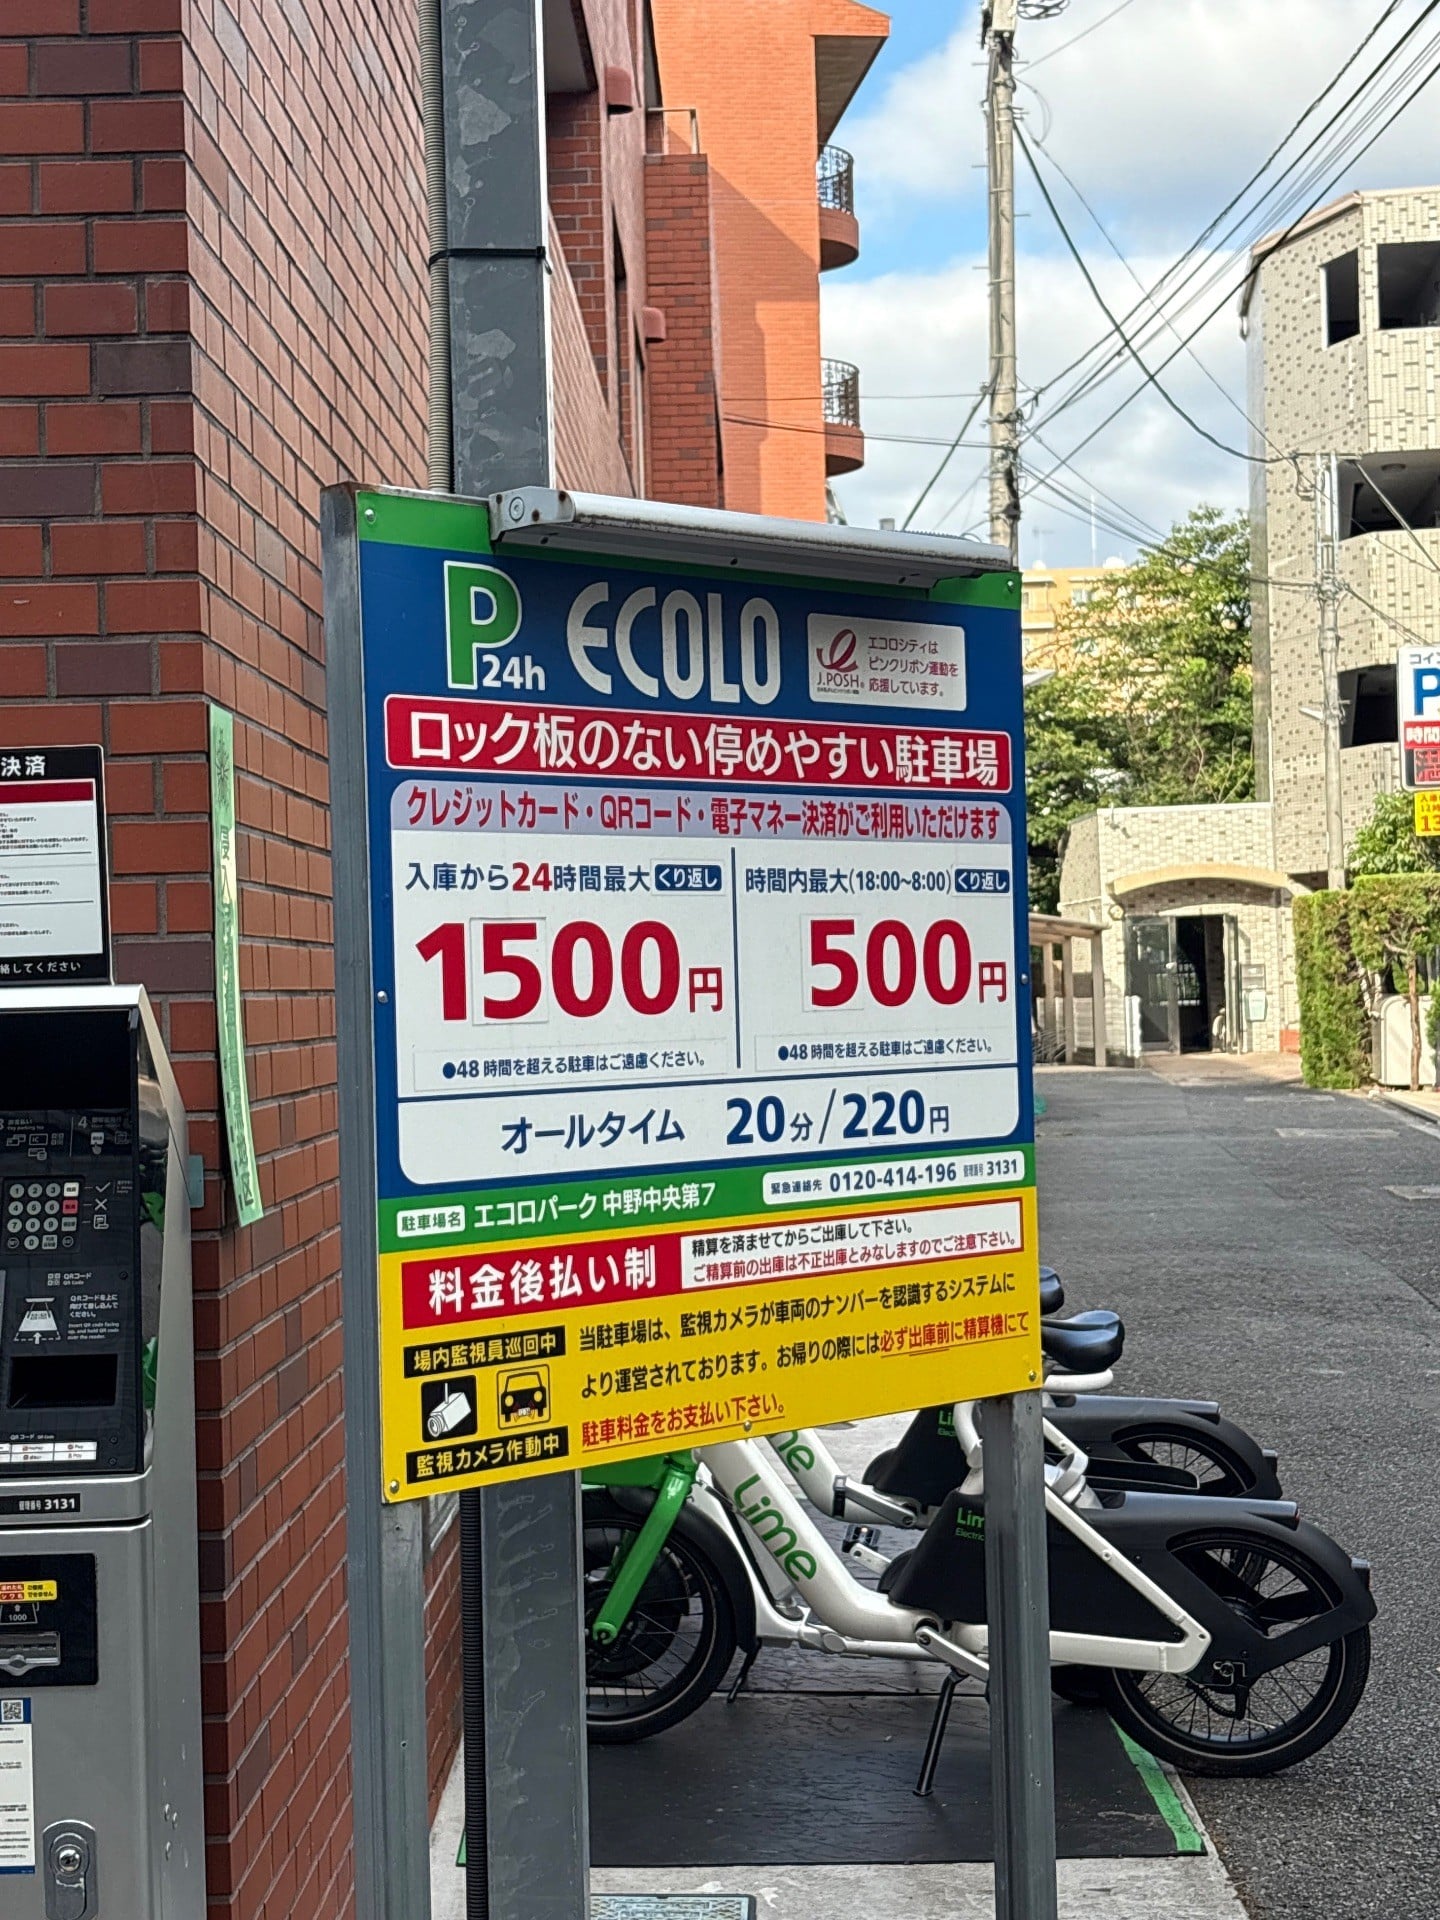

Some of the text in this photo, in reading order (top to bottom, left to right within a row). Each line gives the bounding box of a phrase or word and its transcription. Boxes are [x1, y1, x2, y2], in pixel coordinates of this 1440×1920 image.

[444, 560, 522, 689] P
[567, 582, 781, 705] ECOLO
[868, 636, 938, 655] エコロシティは
[482, 654, 546, 691] 24h
[868, 657, 958, 677] ピンクリボン運動を
[1409, 652, 1440, 664] コイ
[1413, 668, 1440, 715] P
[1, 756, 45, 777] 決済
[411, 712, 998, 787] ロック板のない停めやすい駐車場
[407, 786, 1000, 839] クレジットカード・QRコード・電子マネー決済がご利用いただけます
[405, 862, 718, 892] 入庫から24時間最大 くり返し
[957, 872, 1007, 891] くり返し
[501, 1108, 685, 1154] オールタイム
[771, 1180, 822, 1195] 緊急連絡先
[829, 1163, 957, 1193] 0120-414-196
[987, 1159, 1018, 1177] 3131
[401, 1182, 716, 1232] 駐車場名 エコロパーク 中野中央第7
[692, 1218, 912, 1257] 精算を済ませてからご出庫して下さい。
[694, 1231, 1015, 1282] ご精算前の出庫は不正出庫とみなしますのでご注意下さい。
[429, 1244, 657, 1316] 料金後払い制
[580, 1272, 1015, 1351] 当駐車場は、監視カメラが車両のナンバーを認識するシステムに
[414, 1332, 557, 1371] 場内監視員巡回中
[582, 1393, 784, 1446] 駐車料金をお支払い下さい。
[416, 1433, 560, 1478] 監視カメラ作動中
[44, 1498, 76, 1510] 3131
[956, 1507, 985, 1527] Lim
[734, 1473, 817, 1582] Lime
[9, 1613, 27, 1621] 1000
